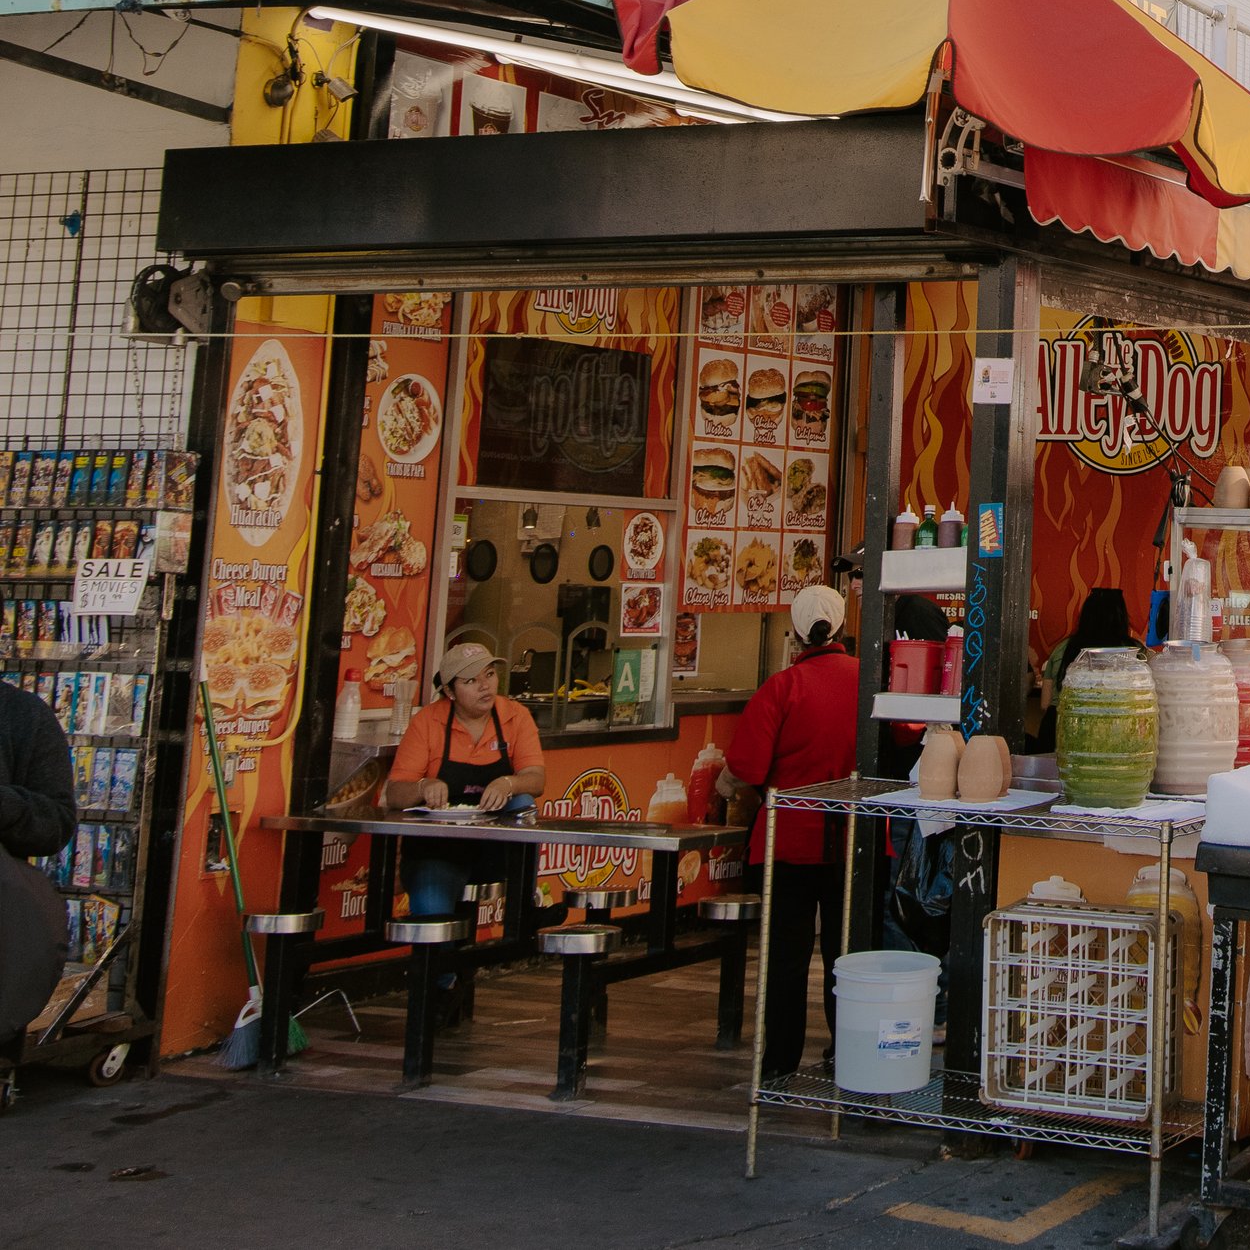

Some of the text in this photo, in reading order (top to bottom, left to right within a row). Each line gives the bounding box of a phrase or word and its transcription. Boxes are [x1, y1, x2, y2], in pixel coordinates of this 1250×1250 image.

[1130, 340, 1224, 459] Dog
[1121, 451, 1143, 467] SINCE
[230, 504, 281, 528] Huarache
[81, 561, 144, 578] SALE
[213, 558, 288, 582] Cheese Burger
[79, 580, 137, 593] 5 MOVIES
[234, 585, 262, 607] Meal
[617, 662, 634, 693] A
[212, 718, 236, 735] heese
[236, 716, 269, 735] Burgers
